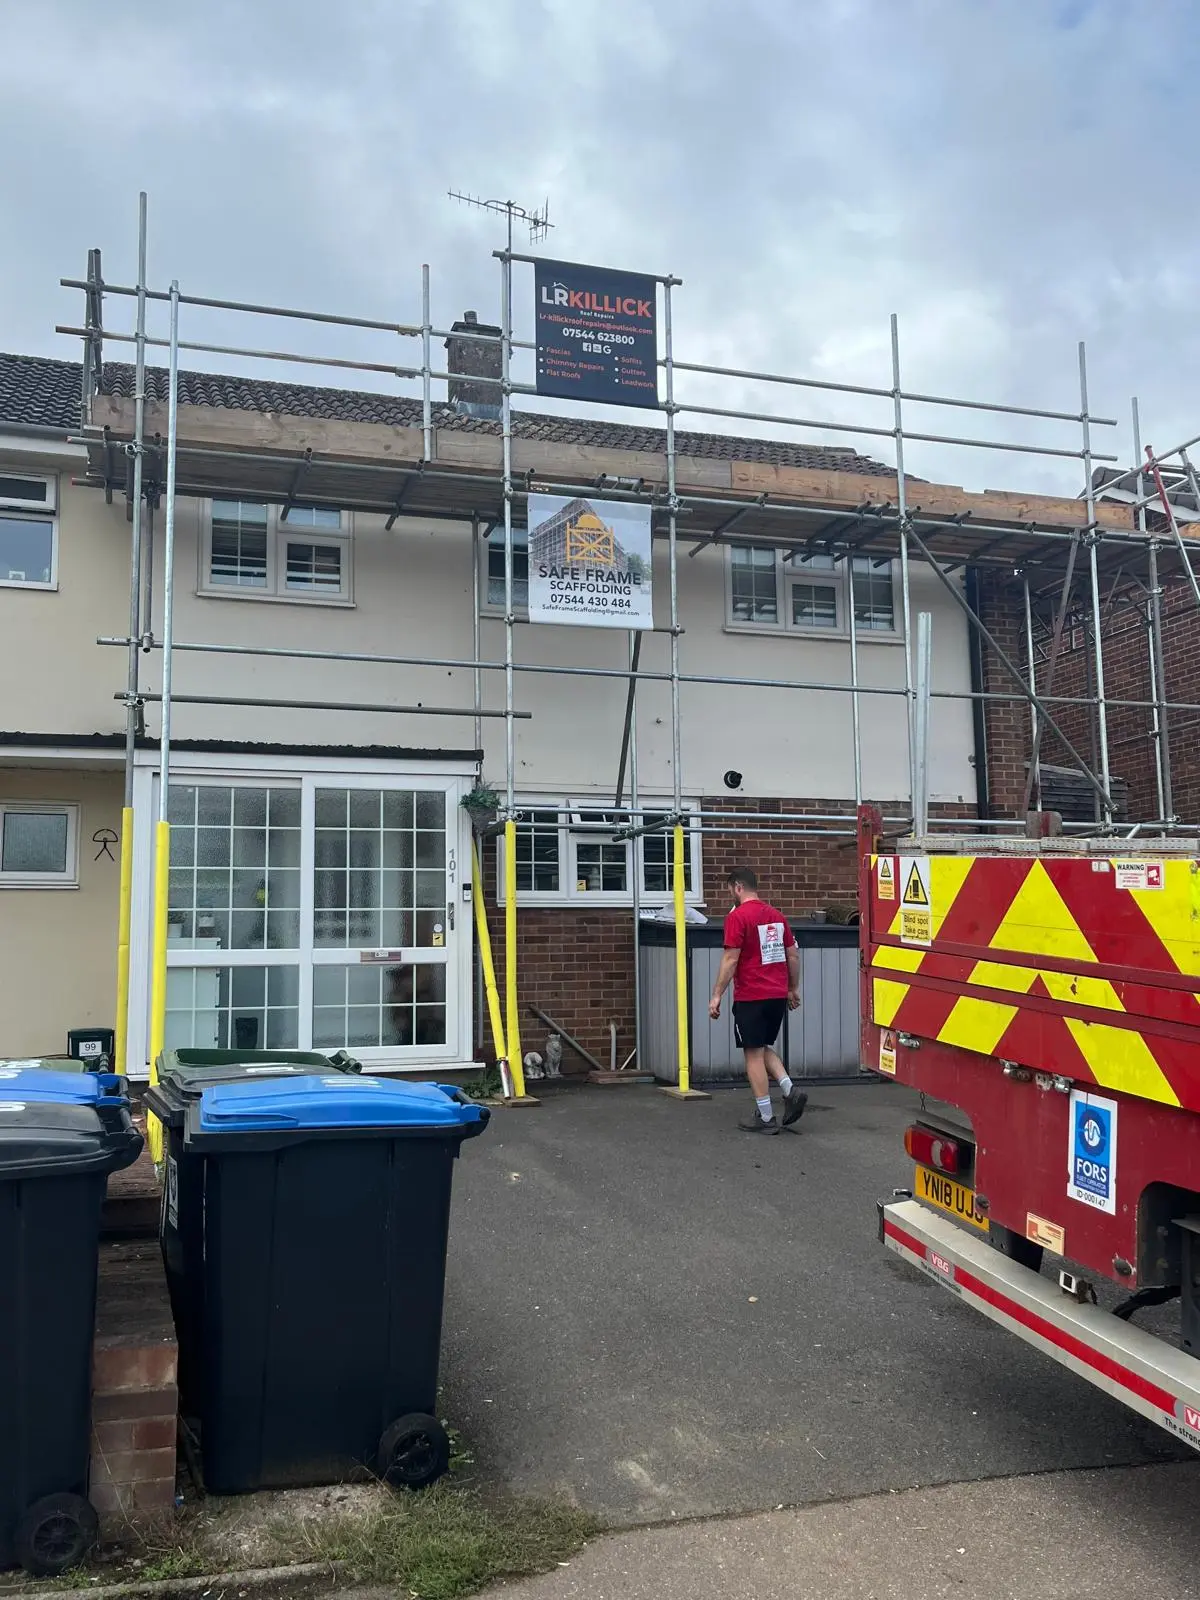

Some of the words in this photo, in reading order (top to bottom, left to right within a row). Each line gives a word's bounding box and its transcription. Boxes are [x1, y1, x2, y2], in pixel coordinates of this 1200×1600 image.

[594, 311, 614, 319] Repairs
[563, 327, 595, 340] 07544
[597, 332, 635, 345] 623800
[546, 347, 571, 355] Fascias
[546, 359, 577, 368] Chimney
[579, 362, 604, 371] Repairs
[621, 357, 642, 365] Soffits
[561, 371, 580, 379] Roofs
[621, 368, 646, 376] Gutters
[621, 379, 654, 388] Leadwork
[539, 565, 580, 581] SAFE
[586, 568, 642, 585] FRAME
[550, 580, 631, 596] SCAFFOLDING
[550, 594, 584, 605] 07544
[588, 597, 608, 607] 430
[611, 598, 631, 608] 484
[542, 604, 640, 616] SafeFrameScaffolding@gmail.com
[1117, 863, 1145, 871] WARNING
[904, 914, 916, 924] Blind
[917, 917, 929, 926] spot
[904, 925, 916, 934] Take
[917, 928, 929, 936] care
[84, 1043, 97, 1052] 99
[1077, 1157, 1107, 1183] FORS
[923, 1171, 952, 1207] YN18
[956, 1187, 984, 1224] UJ
[931, 1253, 949, 1273] VBG
[1164, 1416, 1177, 1431] The
